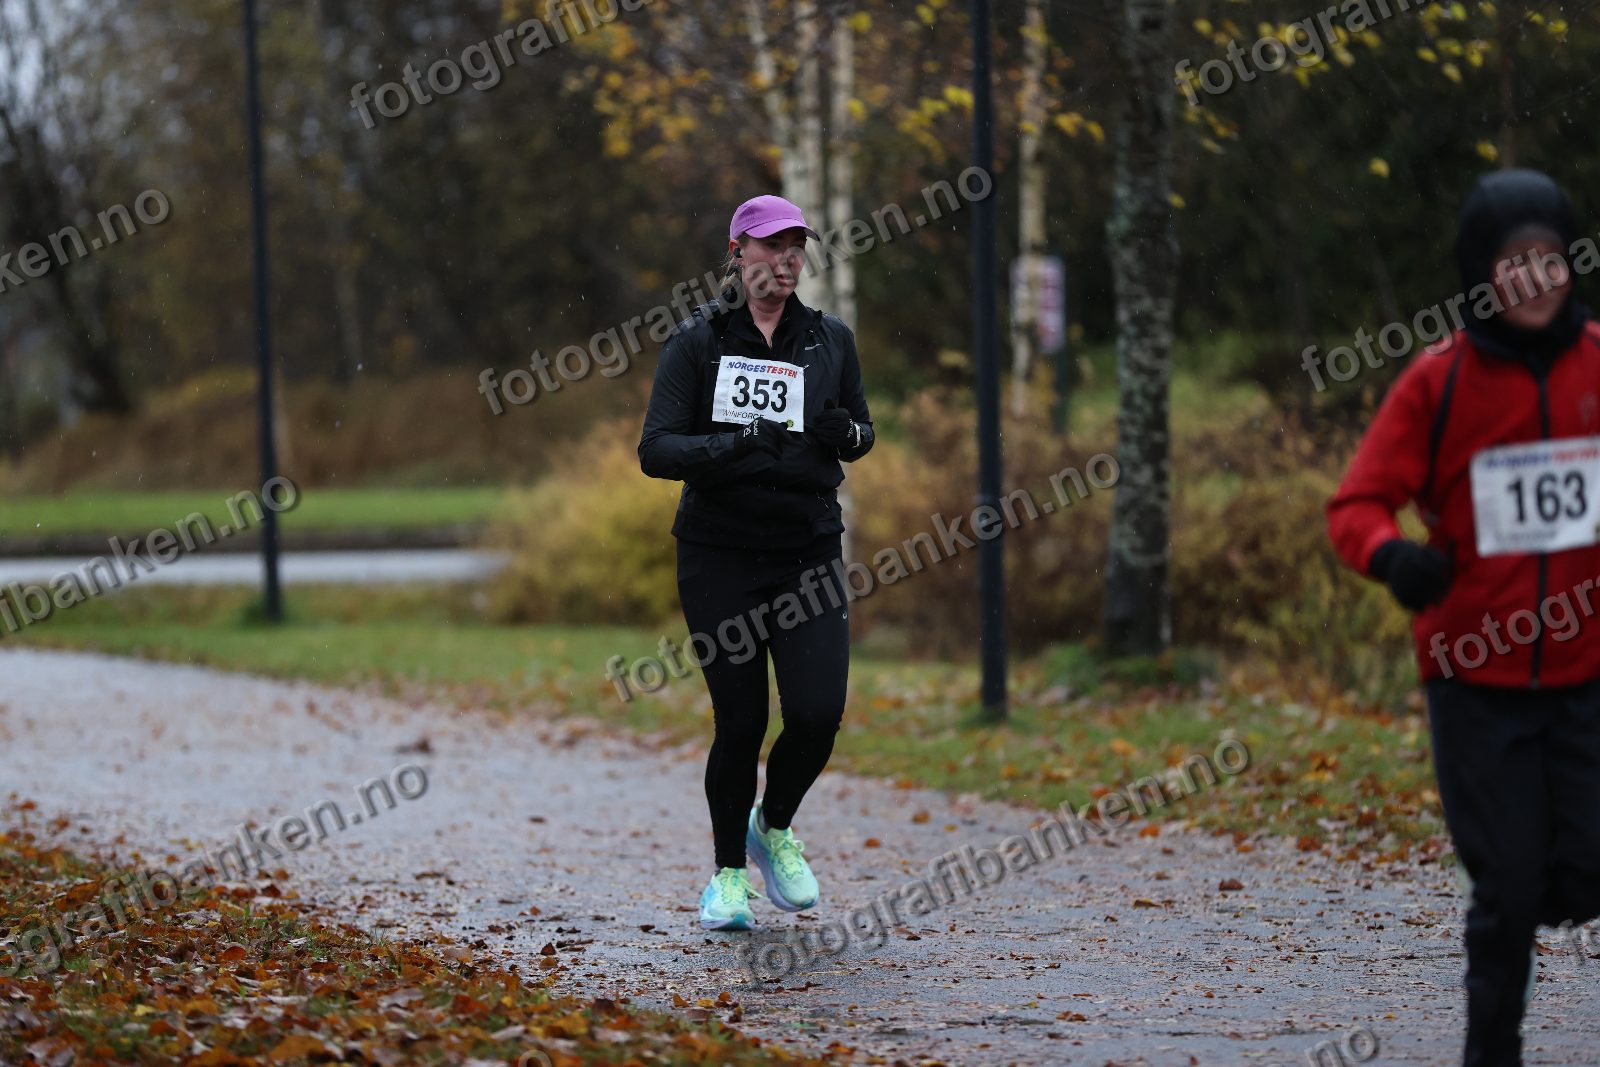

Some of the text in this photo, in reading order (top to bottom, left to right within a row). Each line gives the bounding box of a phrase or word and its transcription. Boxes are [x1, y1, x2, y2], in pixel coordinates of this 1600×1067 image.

[727, 361, 798, 378] NORGESTESTEN
[732, 375, 788, 413] 353
[1507, 469, 1587, 523] 163
